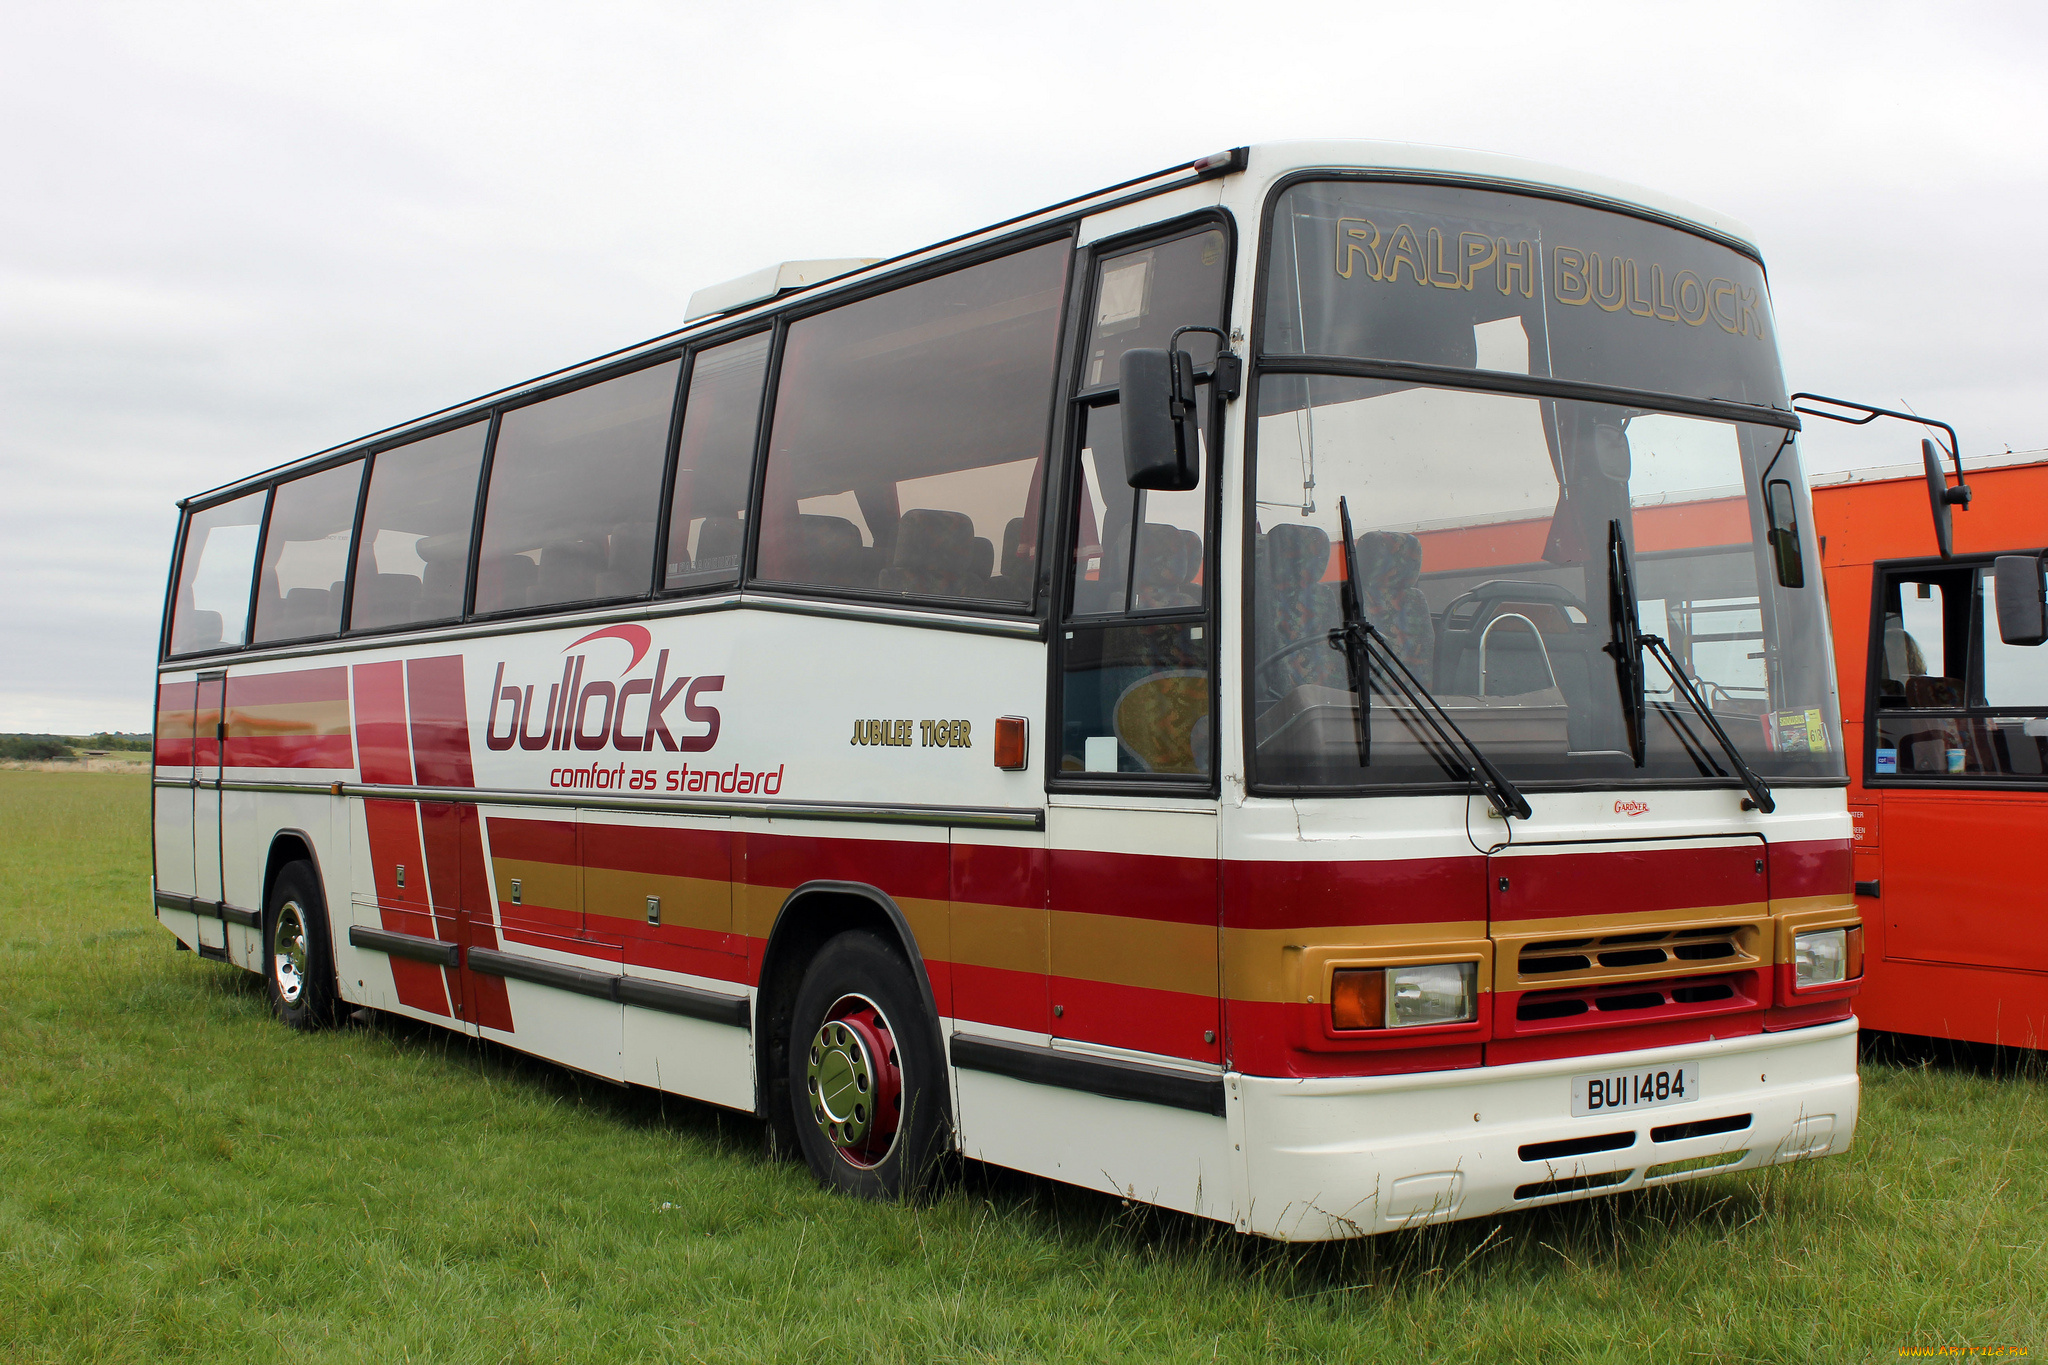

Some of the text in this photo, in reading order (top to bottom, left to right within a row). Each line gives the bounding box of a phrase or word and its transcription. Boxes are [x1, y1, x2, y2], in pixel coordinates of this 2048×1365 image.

[1335, 217, 1765, 340] RALPH BULLOCK
[486, 648, 725, 753] bullocks
[850, 719, 972, 748] JUBILEE TIGER
[550, 761, 785, 795] comfort as standard
[1853, 826, 1866, 834] REEN
[1588, 1069, 1685, 1110] BUI 1484
